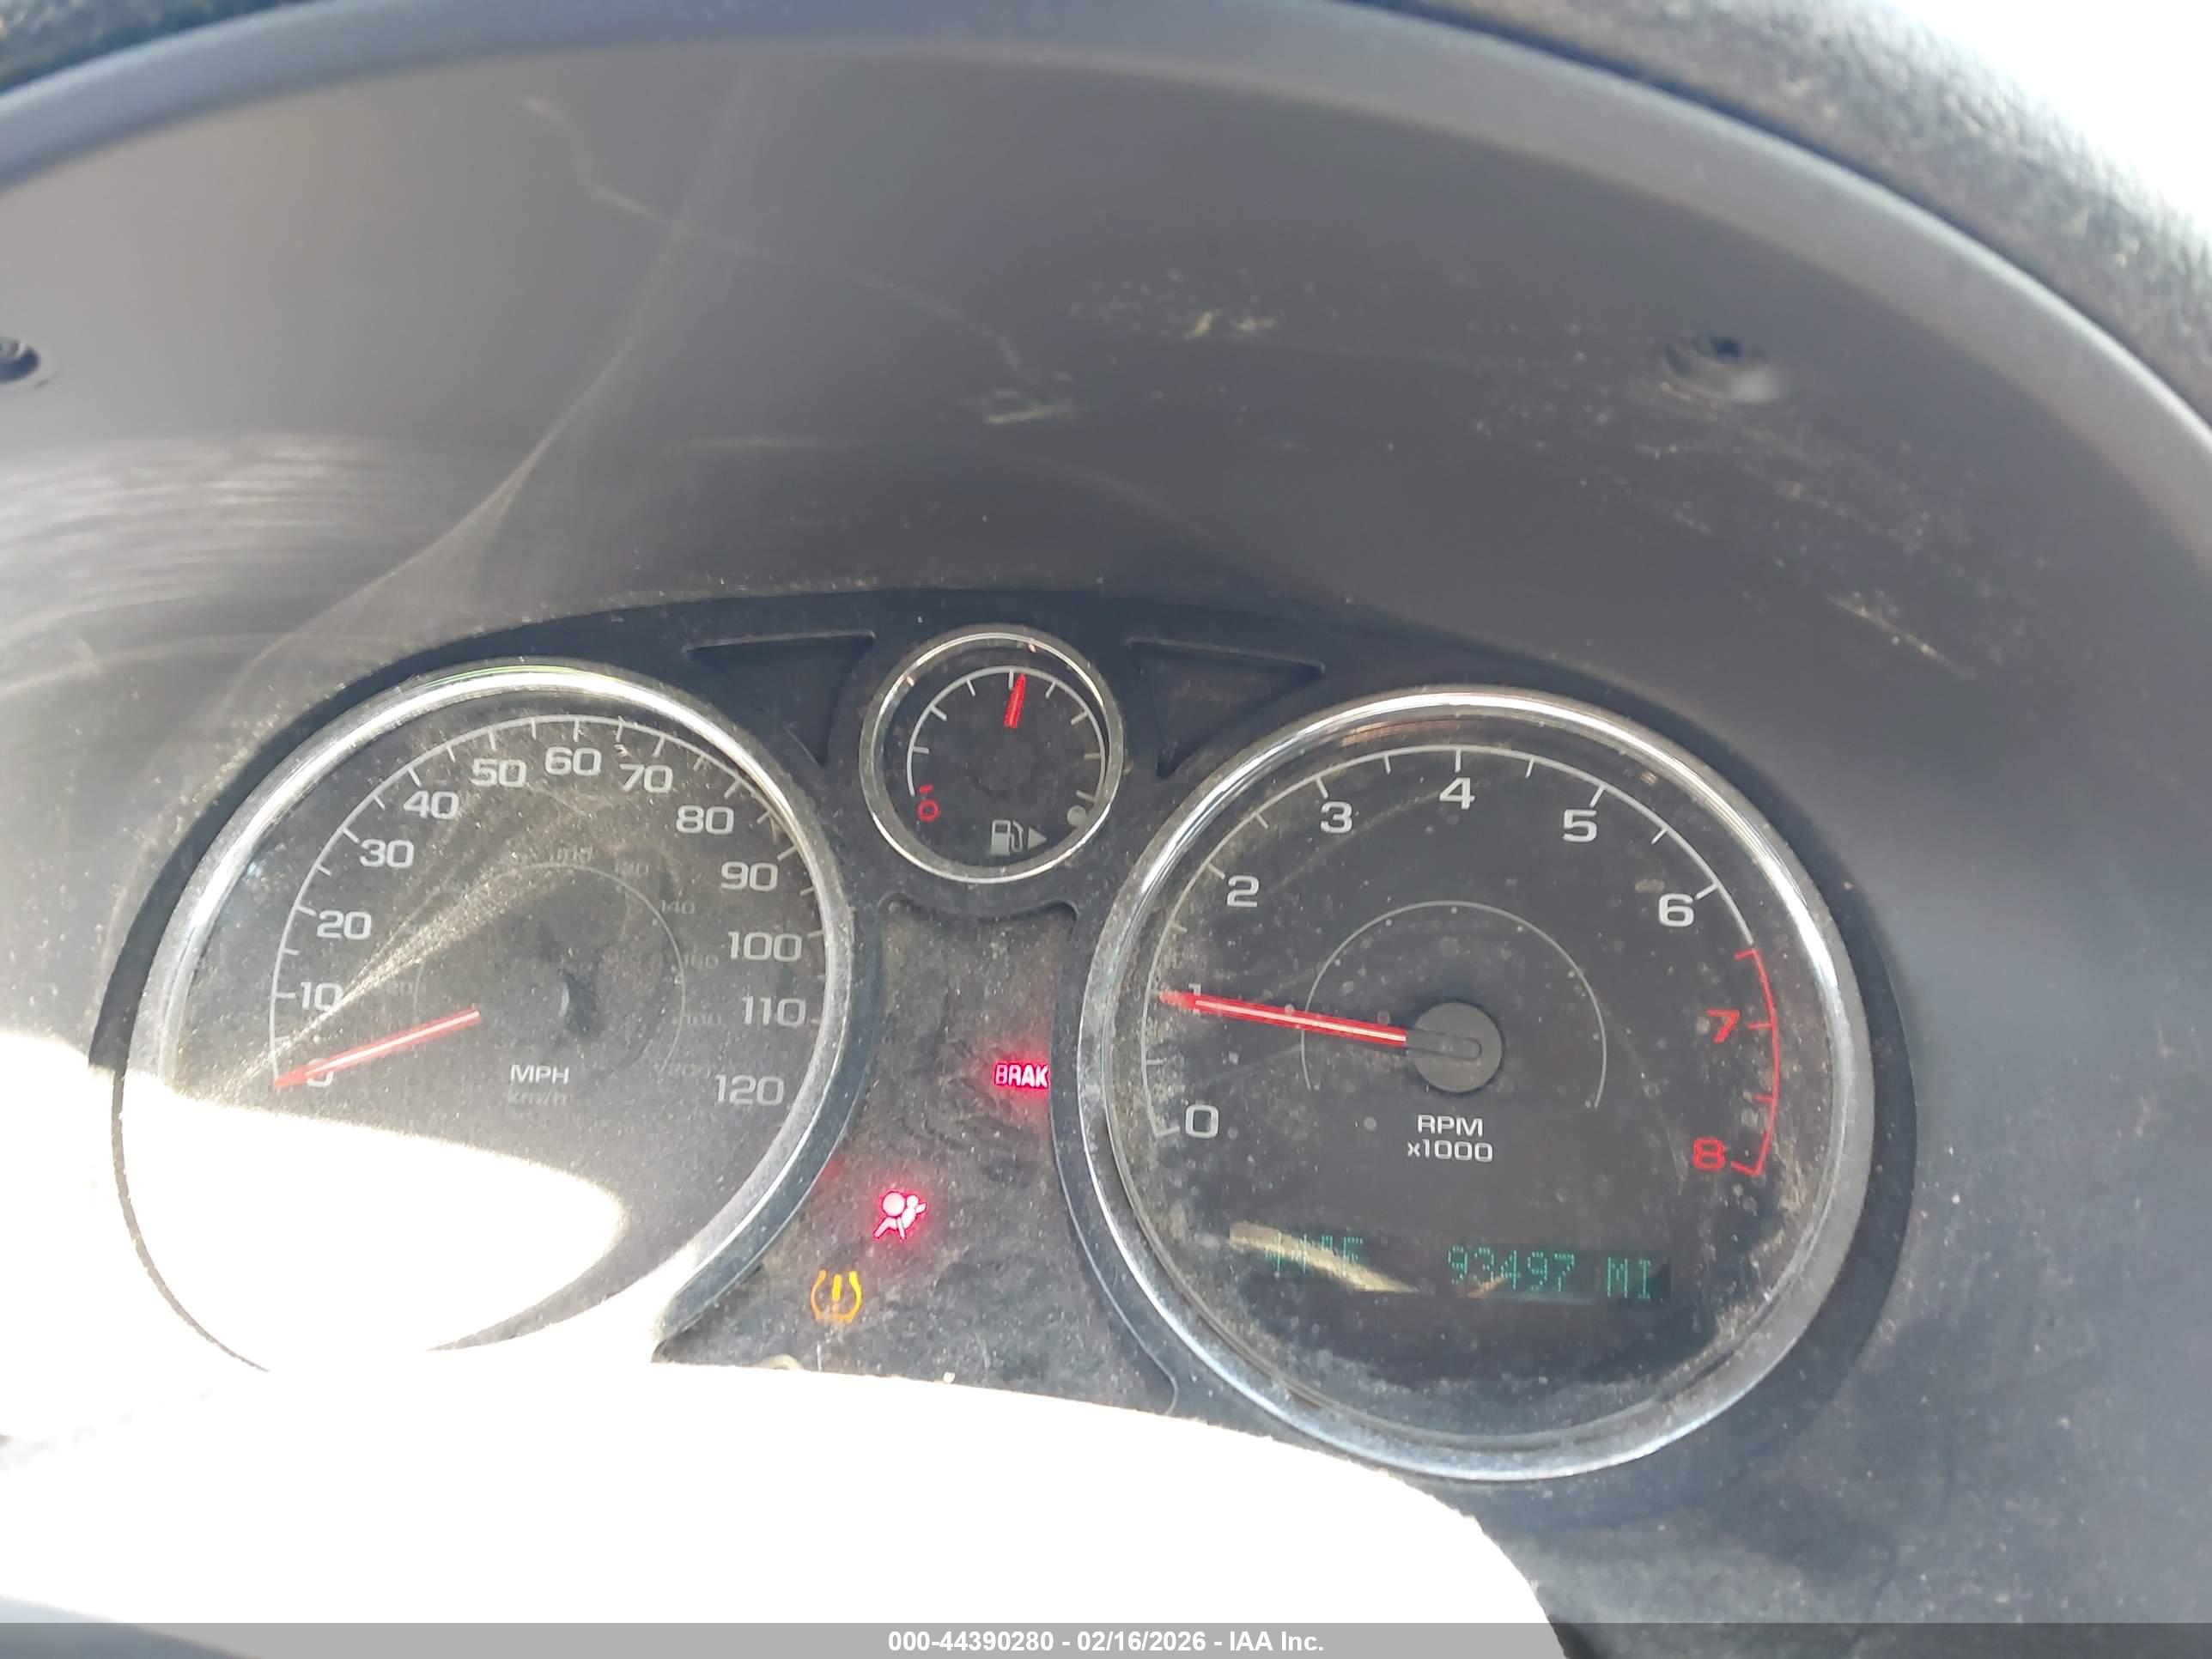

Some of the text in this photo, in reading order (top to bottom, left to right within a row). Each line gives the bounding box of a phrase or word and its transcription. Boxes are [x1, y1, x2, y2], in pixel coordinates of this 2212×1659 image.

[471, 759, 526, 788] 50
[544, 746, 601, 776] 60
[619, 763, 673, 793] 70
[1439, 776, 1475, 811] 4
[404, 791, 459, 819] 40
[676, 805, 734, 835] 80
[1320, 800, 1353, 834] 3
[1562, 808, 1597, 843] 5
[359, 839, 414, 868] 30
[720, 862, 778, 891] 90
[1226, 874, 1260, 908] 2
[316, 911, 372, 940] 20
[1658, 893, 1695, 927] 6
[728, 931, 803, 963] 100
[301, 981, 343, 1012] 10
[741, 996, 806, 1028] 110
[1705, 1009, 1741, 1044] 7
[510, 1064, 569, 1085] MPH
[714, 1074, 785, 1106] 120
[1185, 1103, 1219, 1139] 0
[1417, 1114, 1484, 1137] RPM
[1407, 1139, 1493, 1162] x1000
[1692, 1137, 1728, 1171] 8
[1448, 1244, 1652, 1299] 93497 MI
